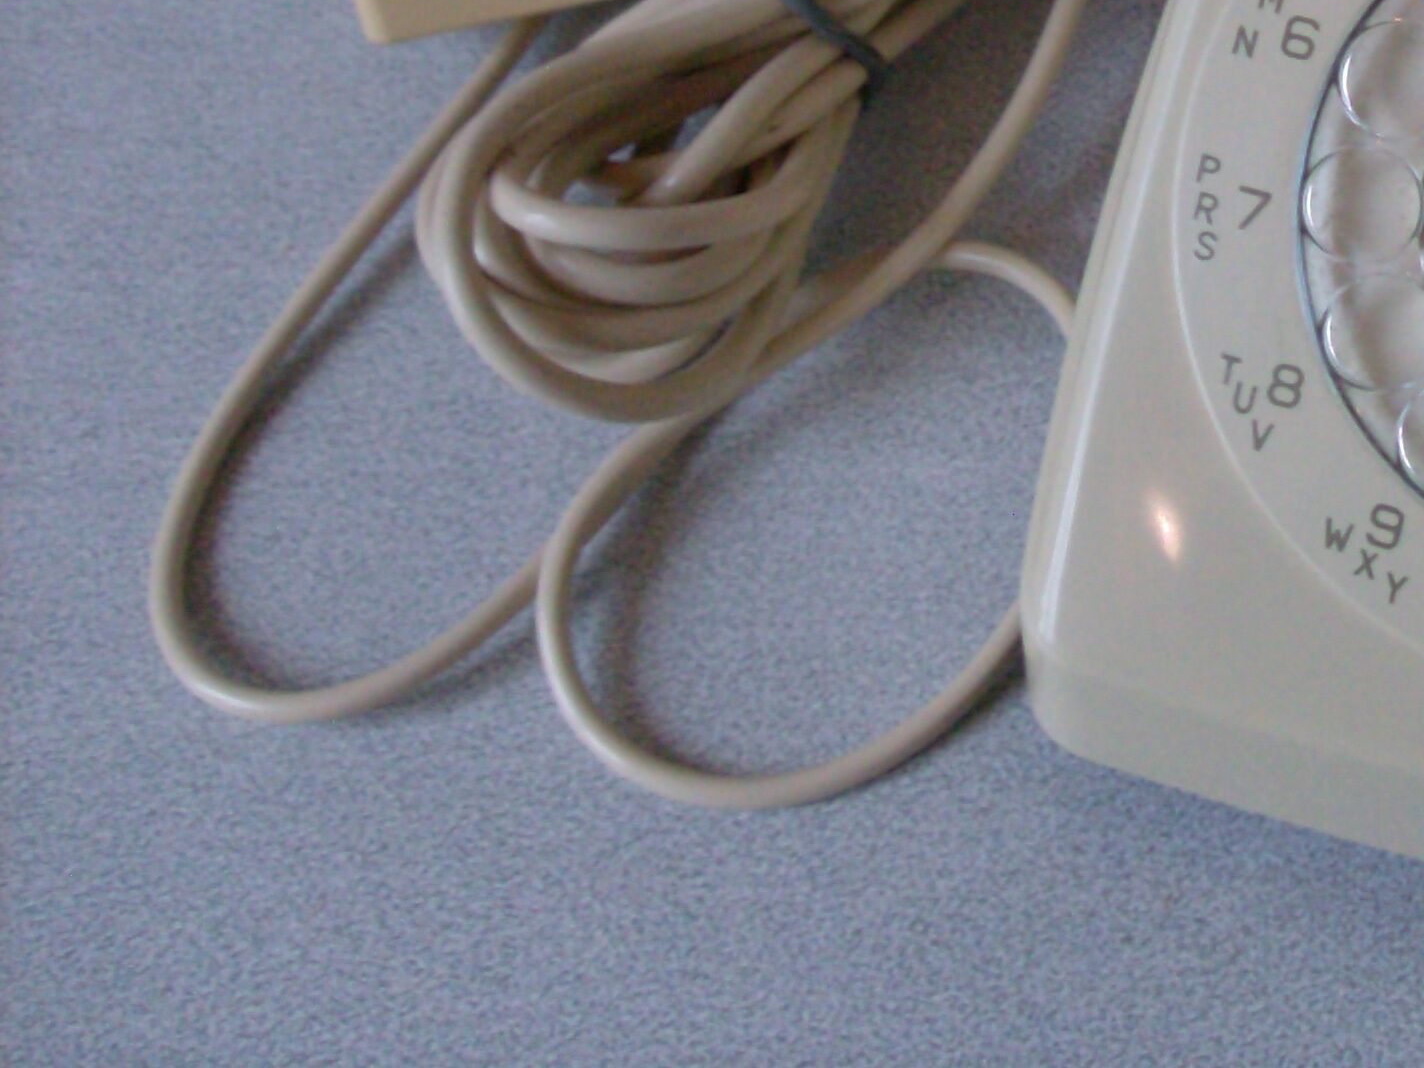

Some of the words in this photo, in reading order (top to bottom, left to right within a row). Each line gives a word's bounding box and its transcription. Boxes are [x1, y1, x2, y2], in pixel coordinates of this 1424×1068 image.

[1280, 15, 1320, 60] 6
[1238, 185, 1272, 230] 7
[1267, 363, 1304, 409] 8
[1366, 503, 1404, 550] 9
